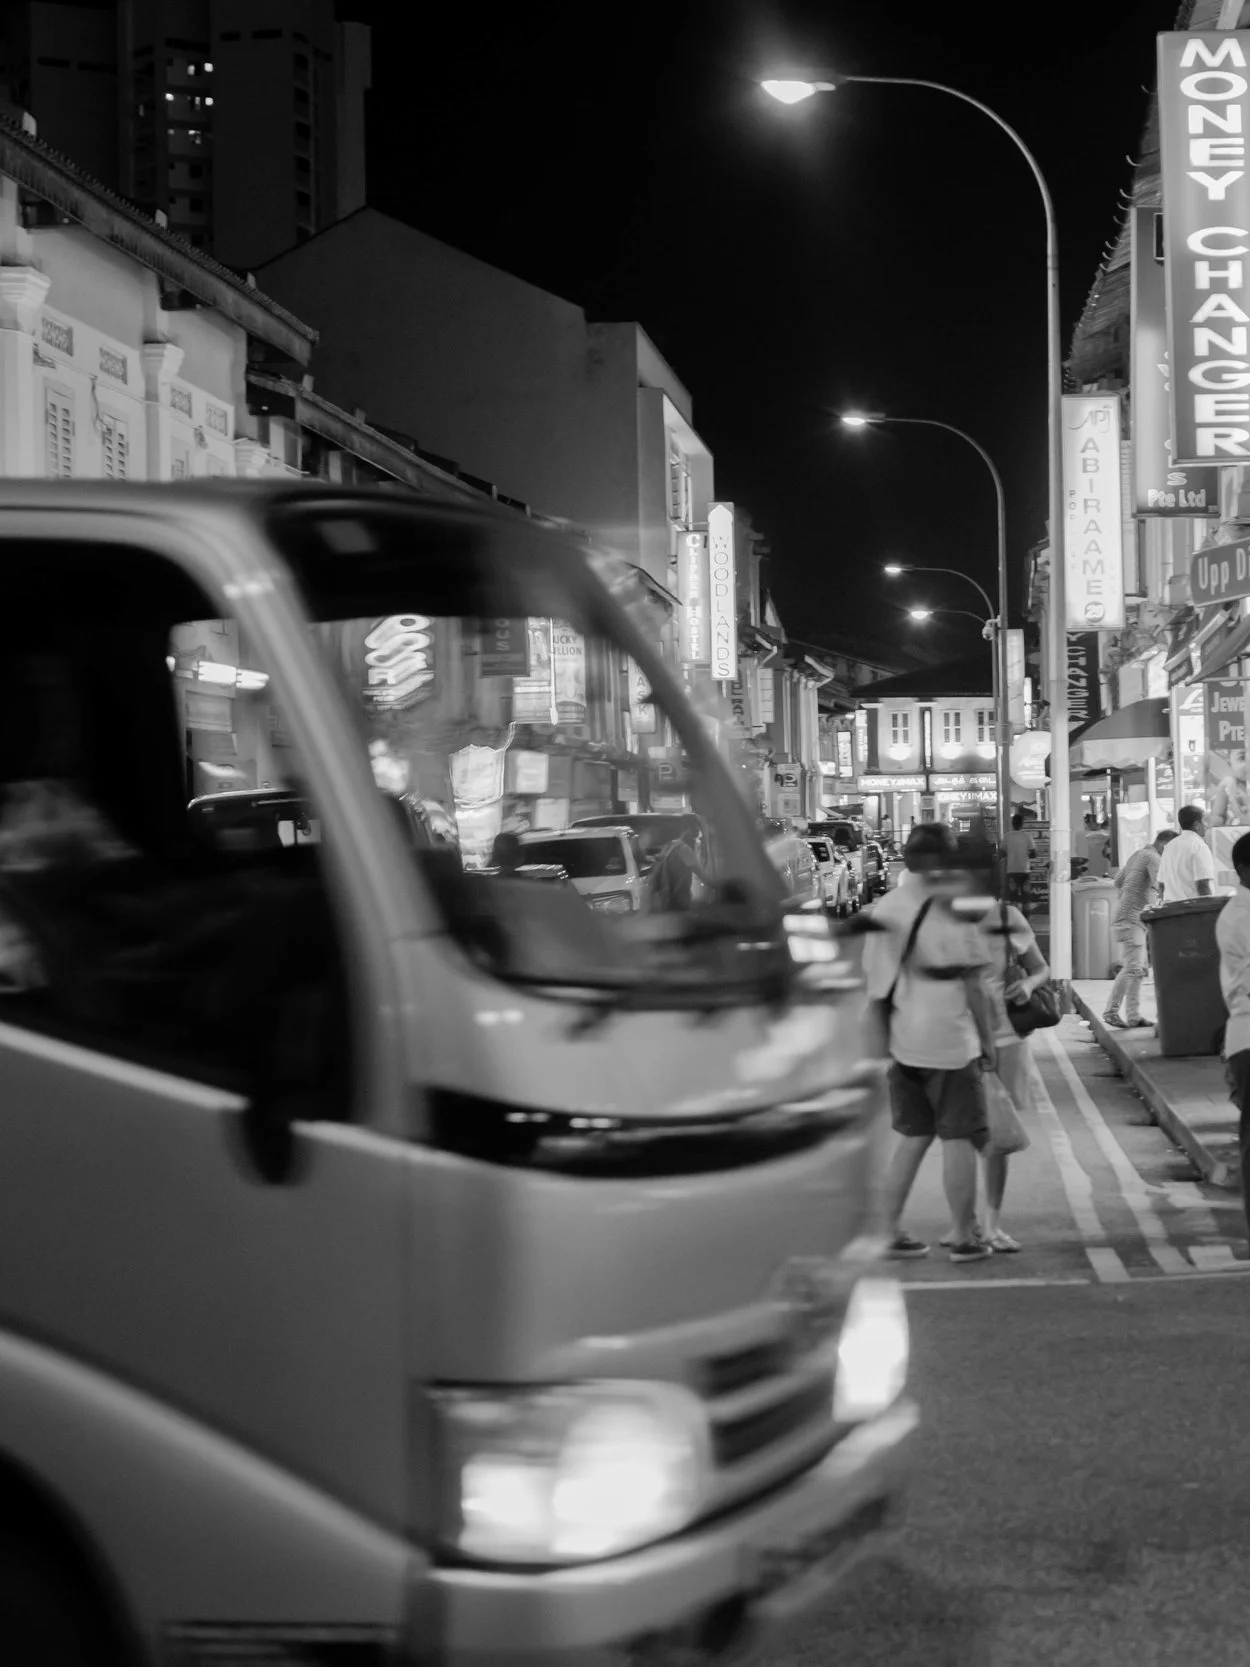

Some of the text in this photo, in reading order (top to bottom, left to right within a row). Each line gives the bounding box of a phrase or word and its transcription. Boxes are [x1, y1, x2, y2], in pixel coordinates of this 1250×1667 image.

[1179, 38, 1247, 200] MONEY
[1080, 437, 1105, 595] ABIRAAME
[1147, 488, 1207, 507] Pte Ltd
[711, 536, 730, 677] WOODLANDS
[1198, 556, 1230, 595] Upp
